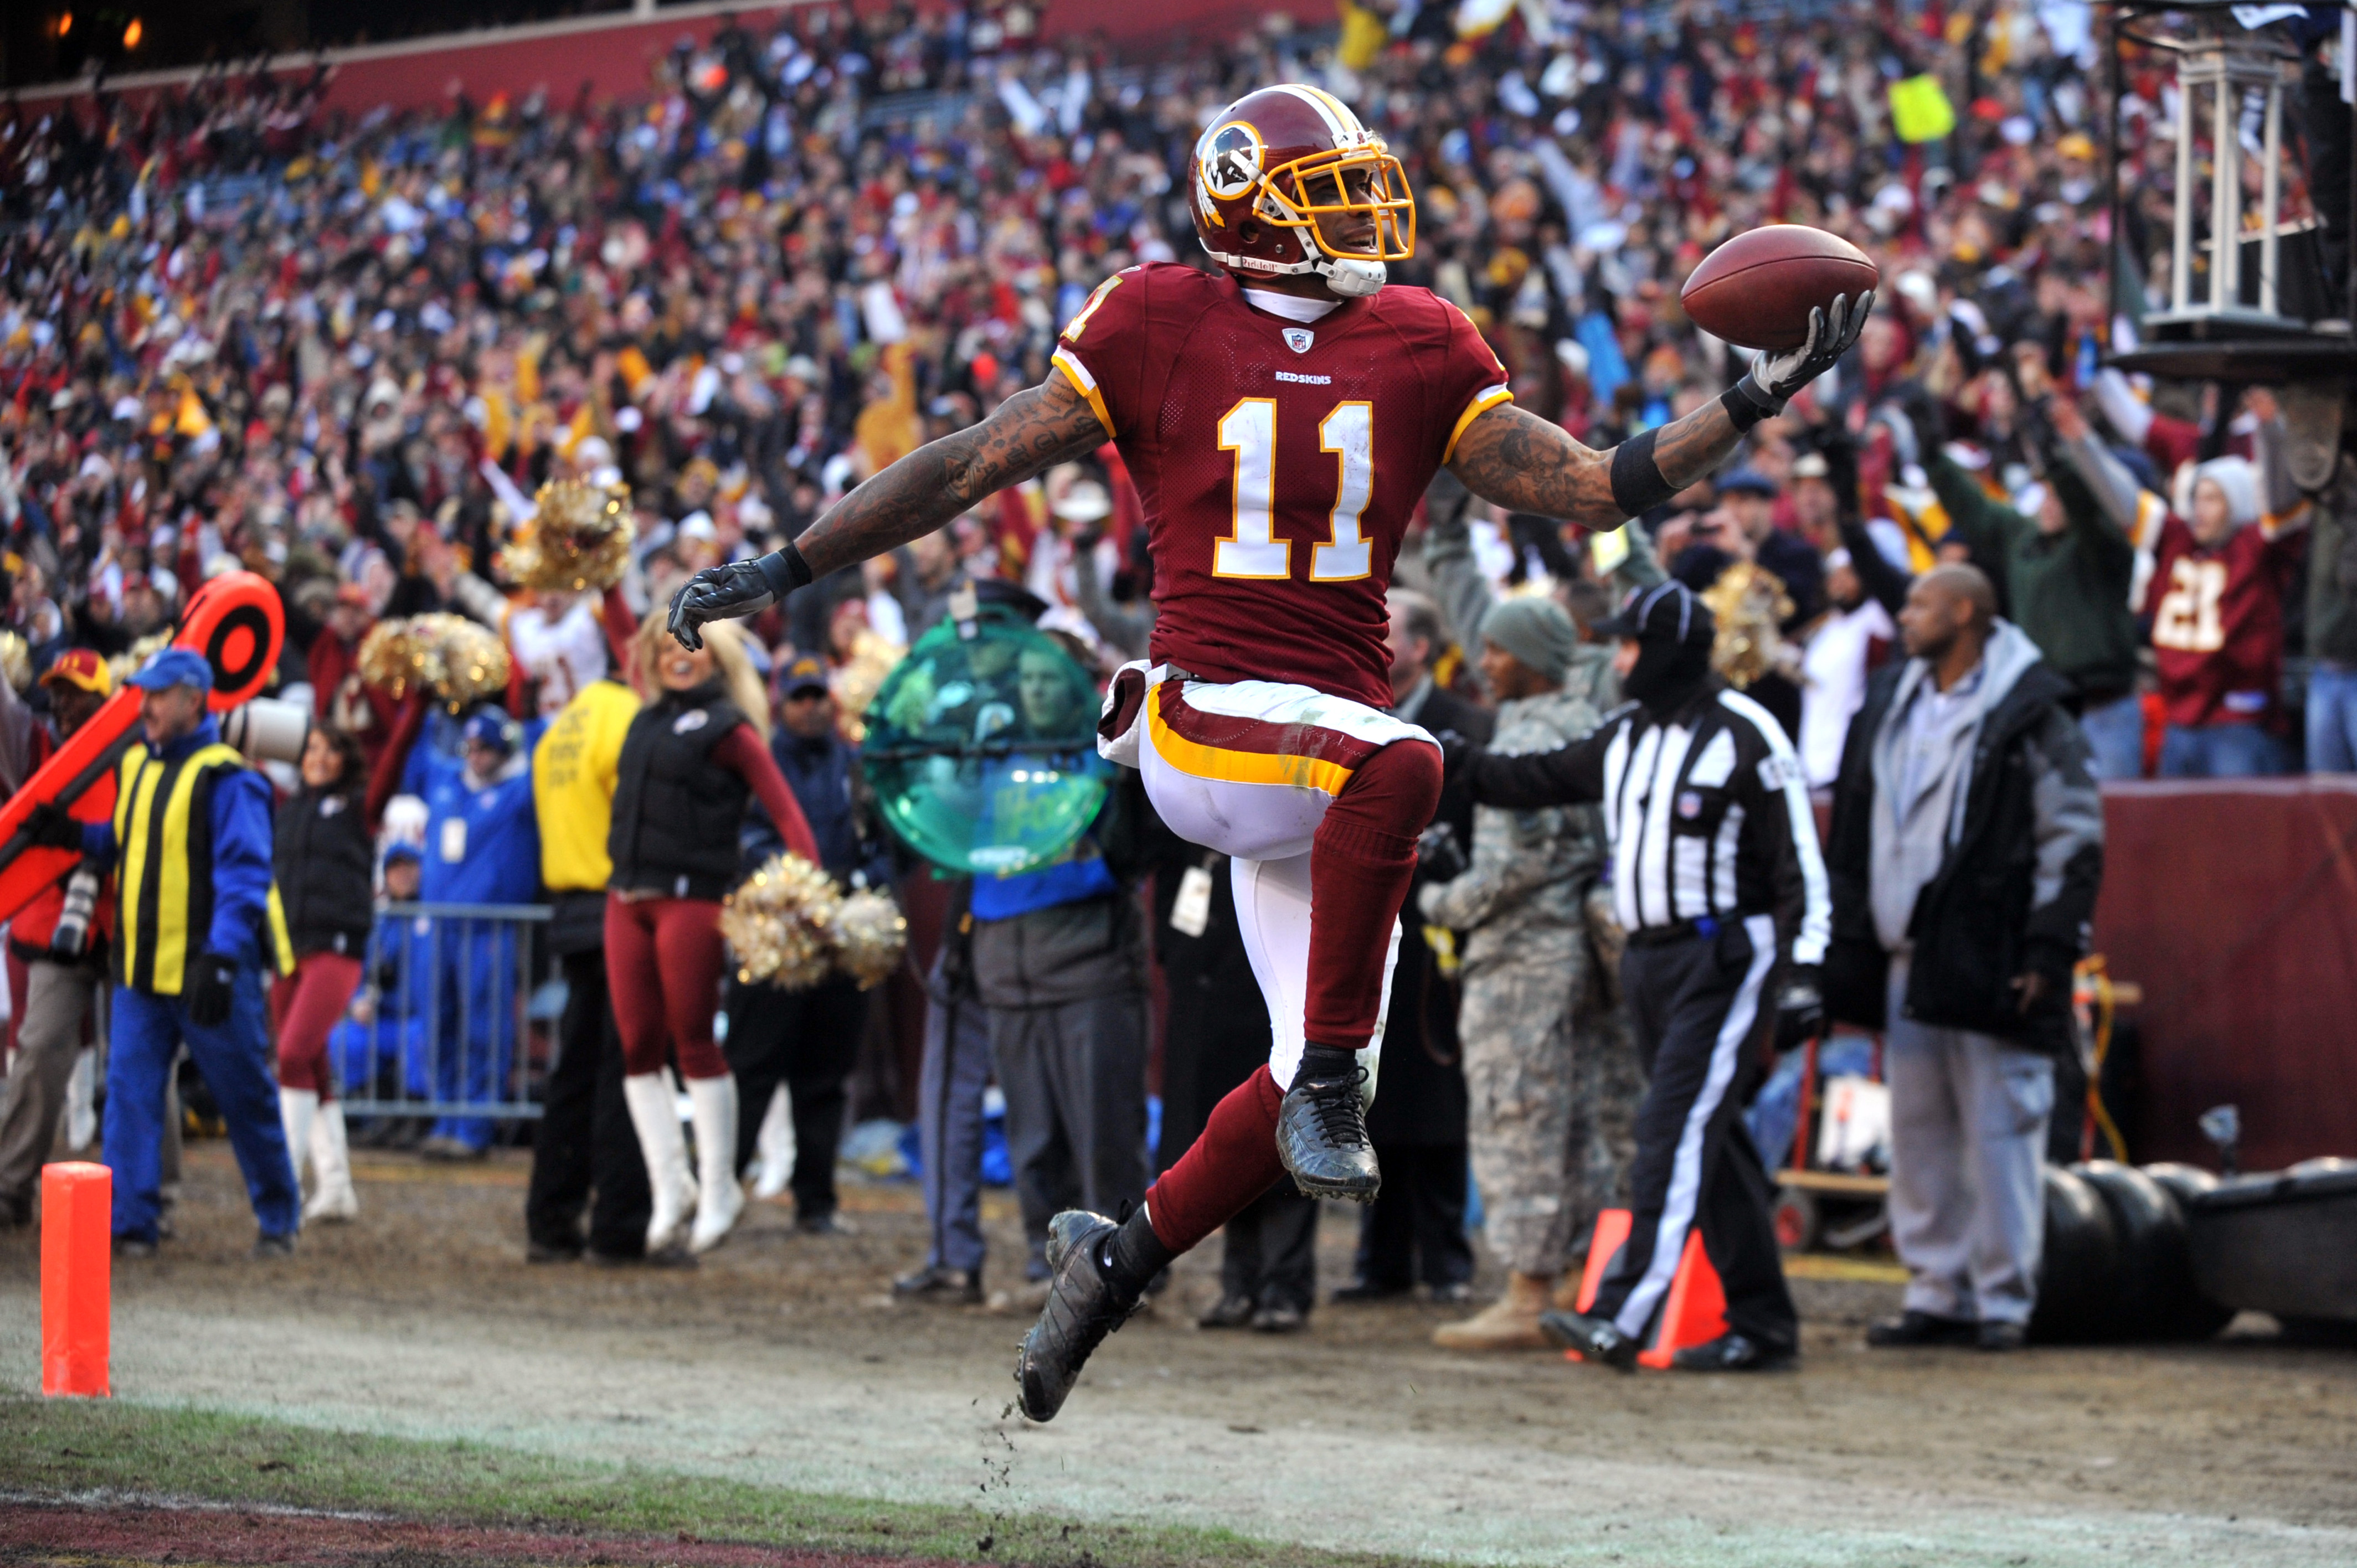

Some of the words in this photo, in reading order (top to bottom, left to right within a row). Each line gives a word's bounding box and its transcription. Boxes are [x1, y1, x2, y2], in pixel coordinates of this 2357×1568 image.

[1294, 340, 1305, 348] NFL
[1275, 372, 1331, 385] REDSKINS
[1213, 397, 1373, 581] 11
[2154, 555, 2226, 651] 21
